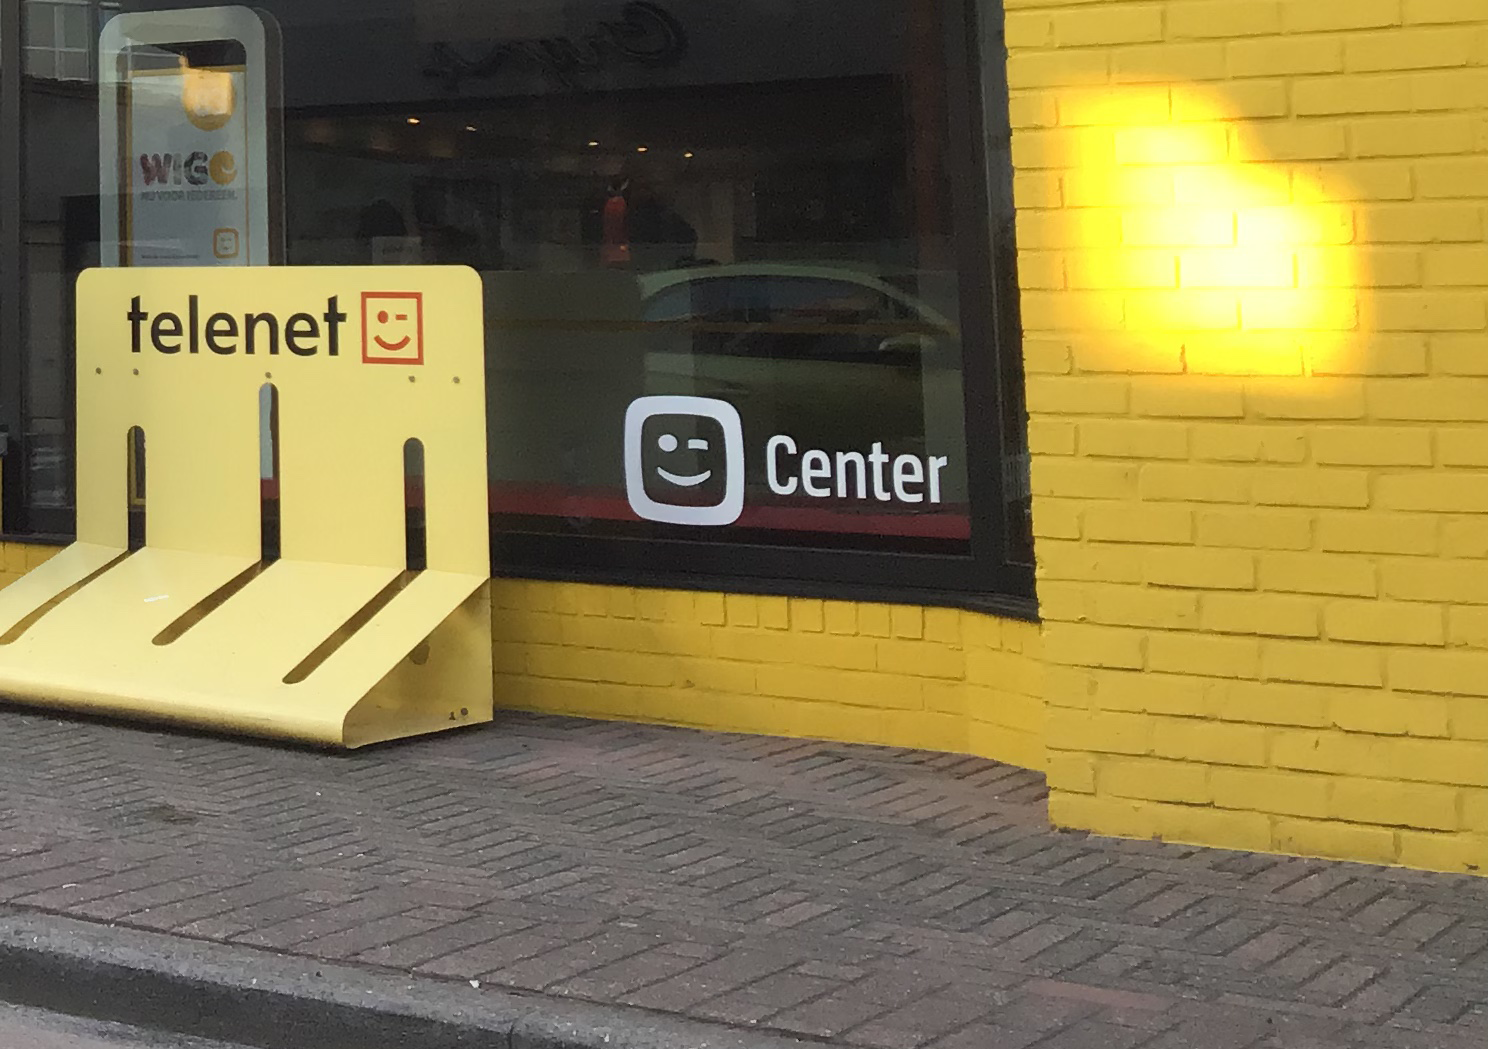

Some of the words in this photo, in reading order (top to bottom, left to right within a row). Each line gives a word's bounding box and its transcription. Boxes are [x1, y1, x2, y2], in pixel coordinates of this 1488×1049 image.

[156, 191, 185, 201] VOOR
[127, 295, 347, 356] telenet
[766, 434, 948, 503] Center
